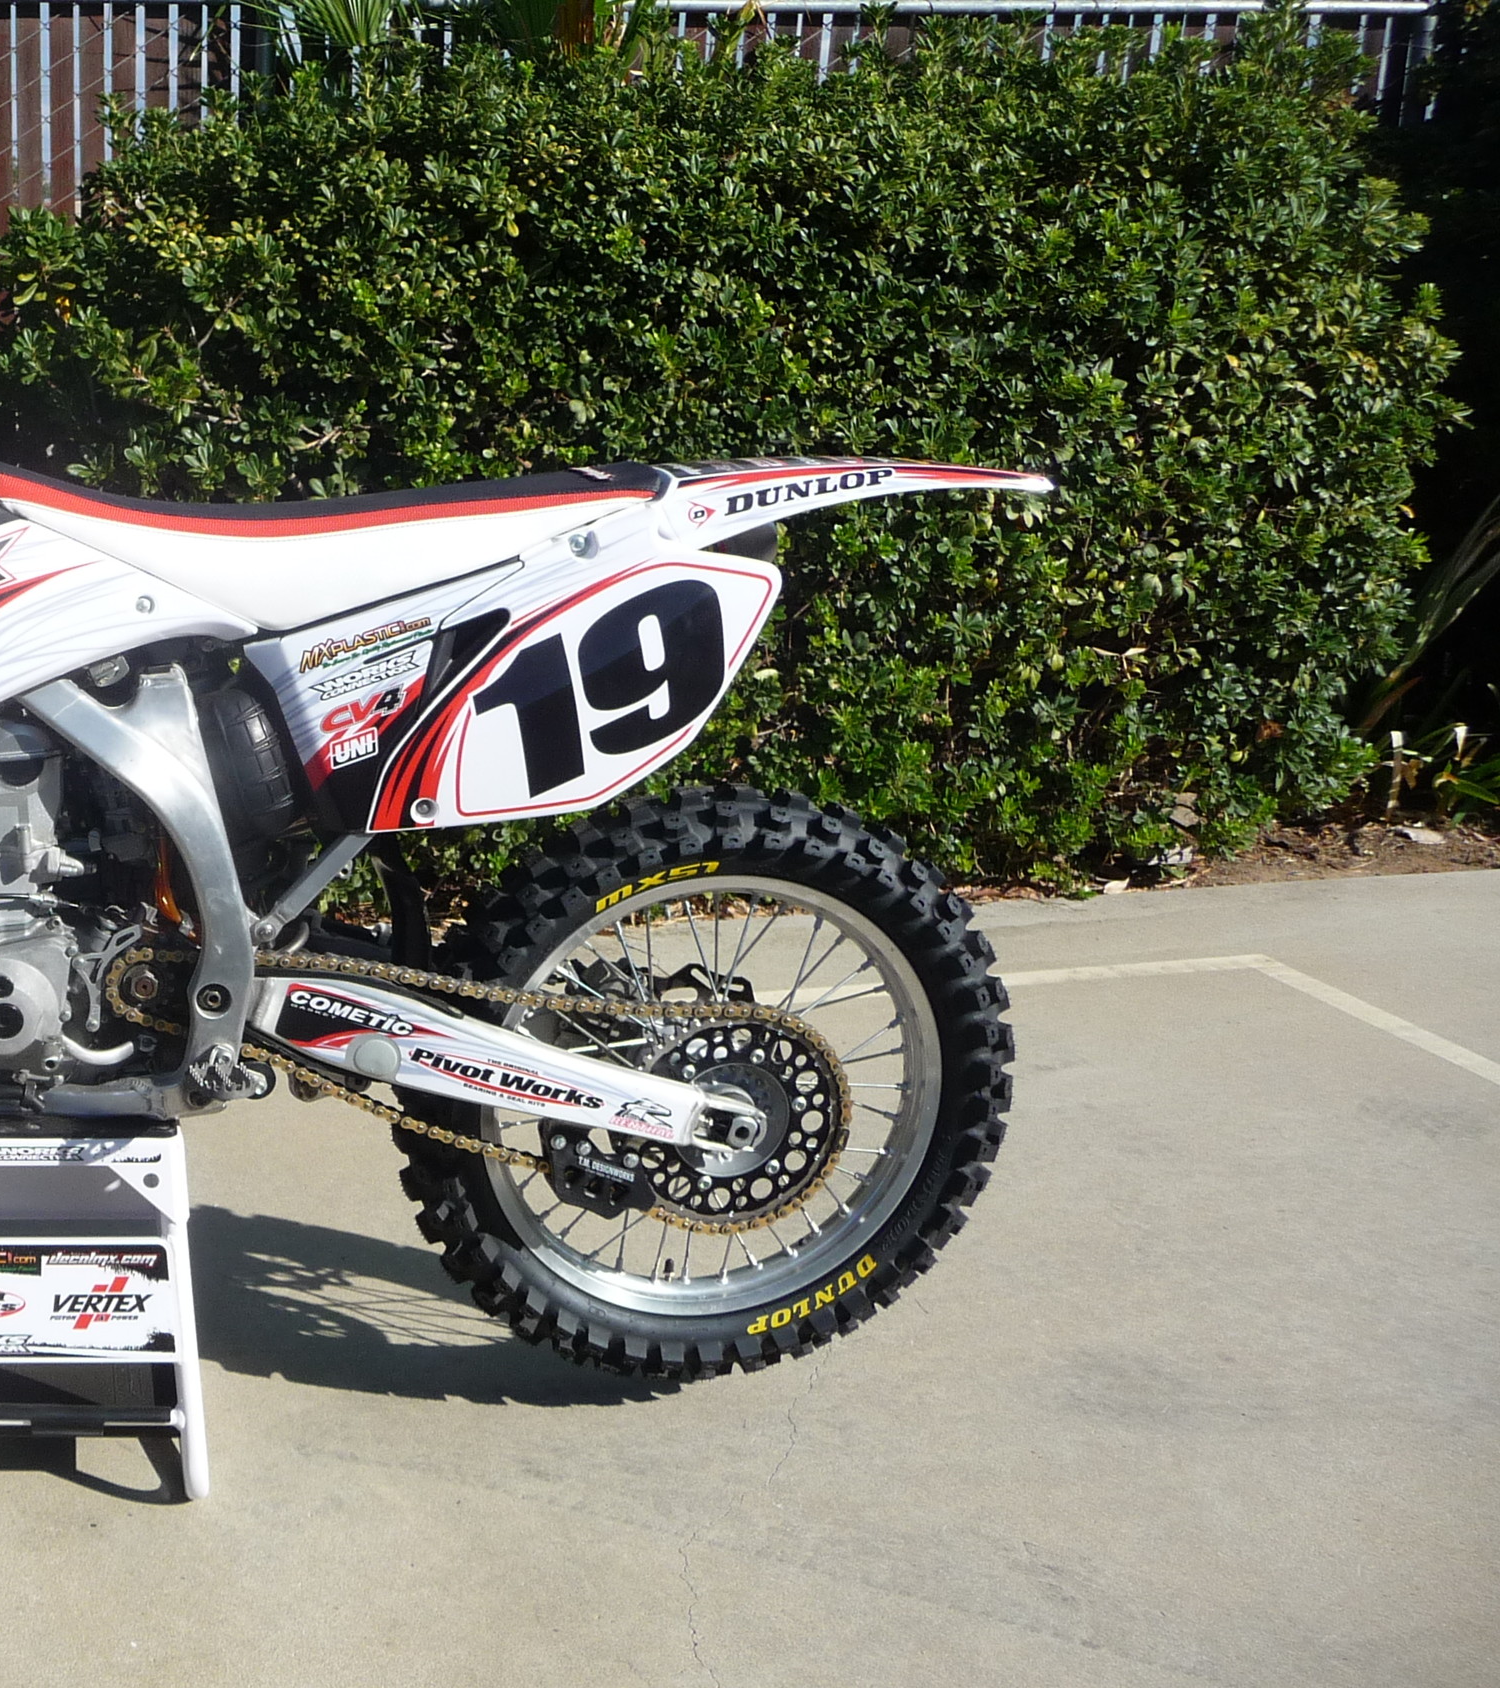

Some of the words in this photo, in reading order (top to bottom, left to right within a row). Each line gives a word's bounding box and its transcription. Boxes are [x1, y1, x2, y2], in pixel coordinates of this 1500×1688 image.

[724, 469, 893, 517] DUNLOP
[312, 652, 415, 691] WORKS
[321, 663, 418, 700] CONNECTION
[467, 579, 727, 799] 19
[320, 684, 404, 733] CV4
[333, 732, 375, 763] UNI
[595, 861, 720, 914] MX51
[290, 990, 414, 1036] COMETIC
[410, 1047, 496, 1084] Pivot
[499, 1072, 605, 1110] Works
[463, 1082, 498, 1098] BEARING
[608, 1115, 675, 1140] RENTHAL
[591, 1161, 636, 1183] DESIGNWORKS
[53, 1294, 153, 1313] VERTEX
[747, 1253, 877, 1335] DUNLOP
